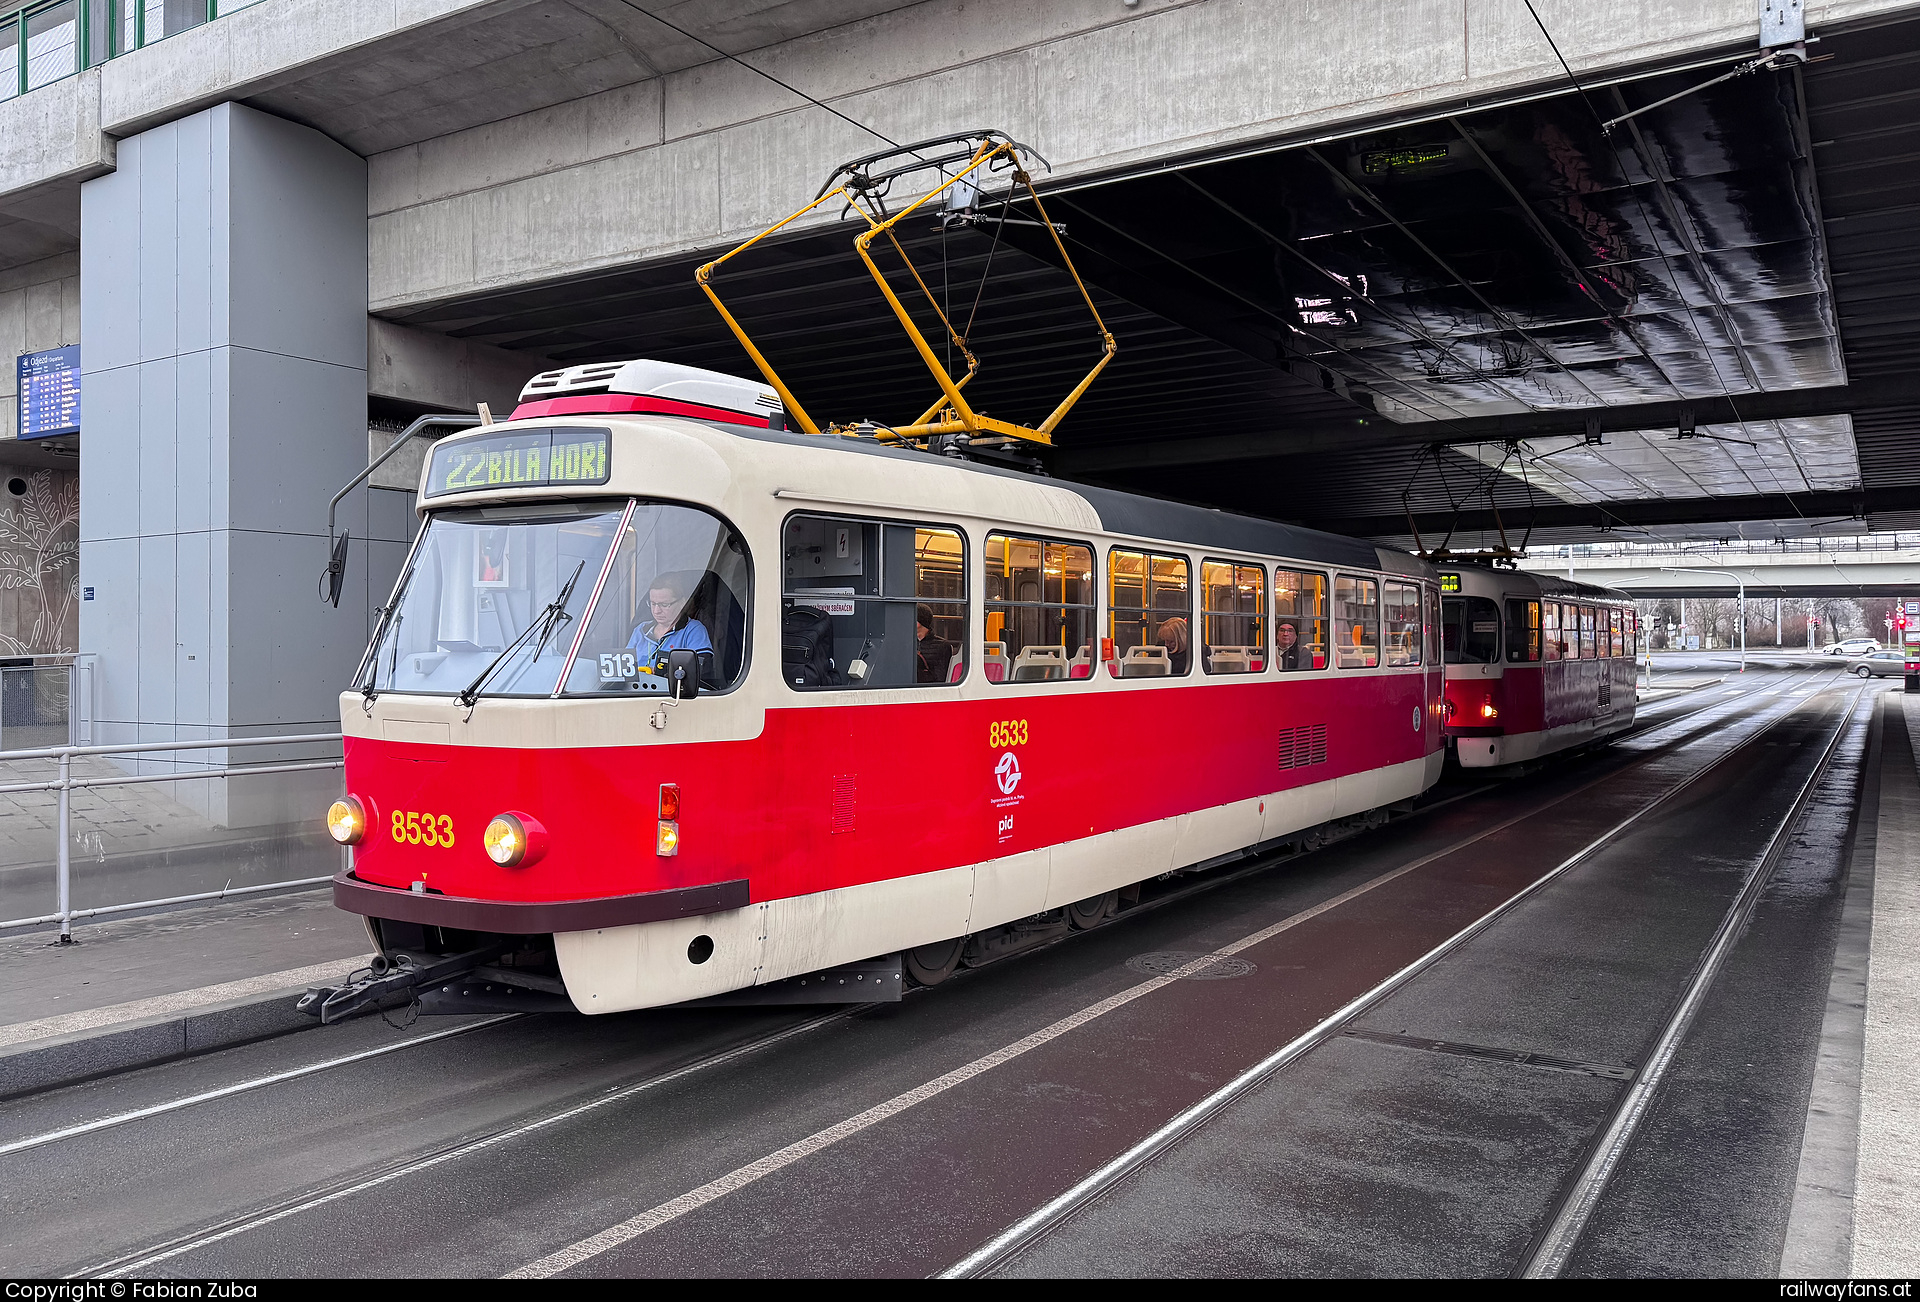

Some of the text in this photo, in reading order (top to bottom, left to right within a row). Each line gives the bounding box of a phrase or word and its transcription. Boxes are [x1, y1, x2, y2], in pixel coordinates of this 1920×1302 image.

[31, 355, 48, 366] Odjezd
[446, 447, 486, 489] 22
[488, 441, 541, 484] BÍLÁ
[831, 603, 853, 612] SBĚRAČEM
[599, 653, 636, 677] 513
[990, 719, 1029, 748] 8533
[391, 809, 455, 848] 8533
[998, 814, 1014, 835] pid
